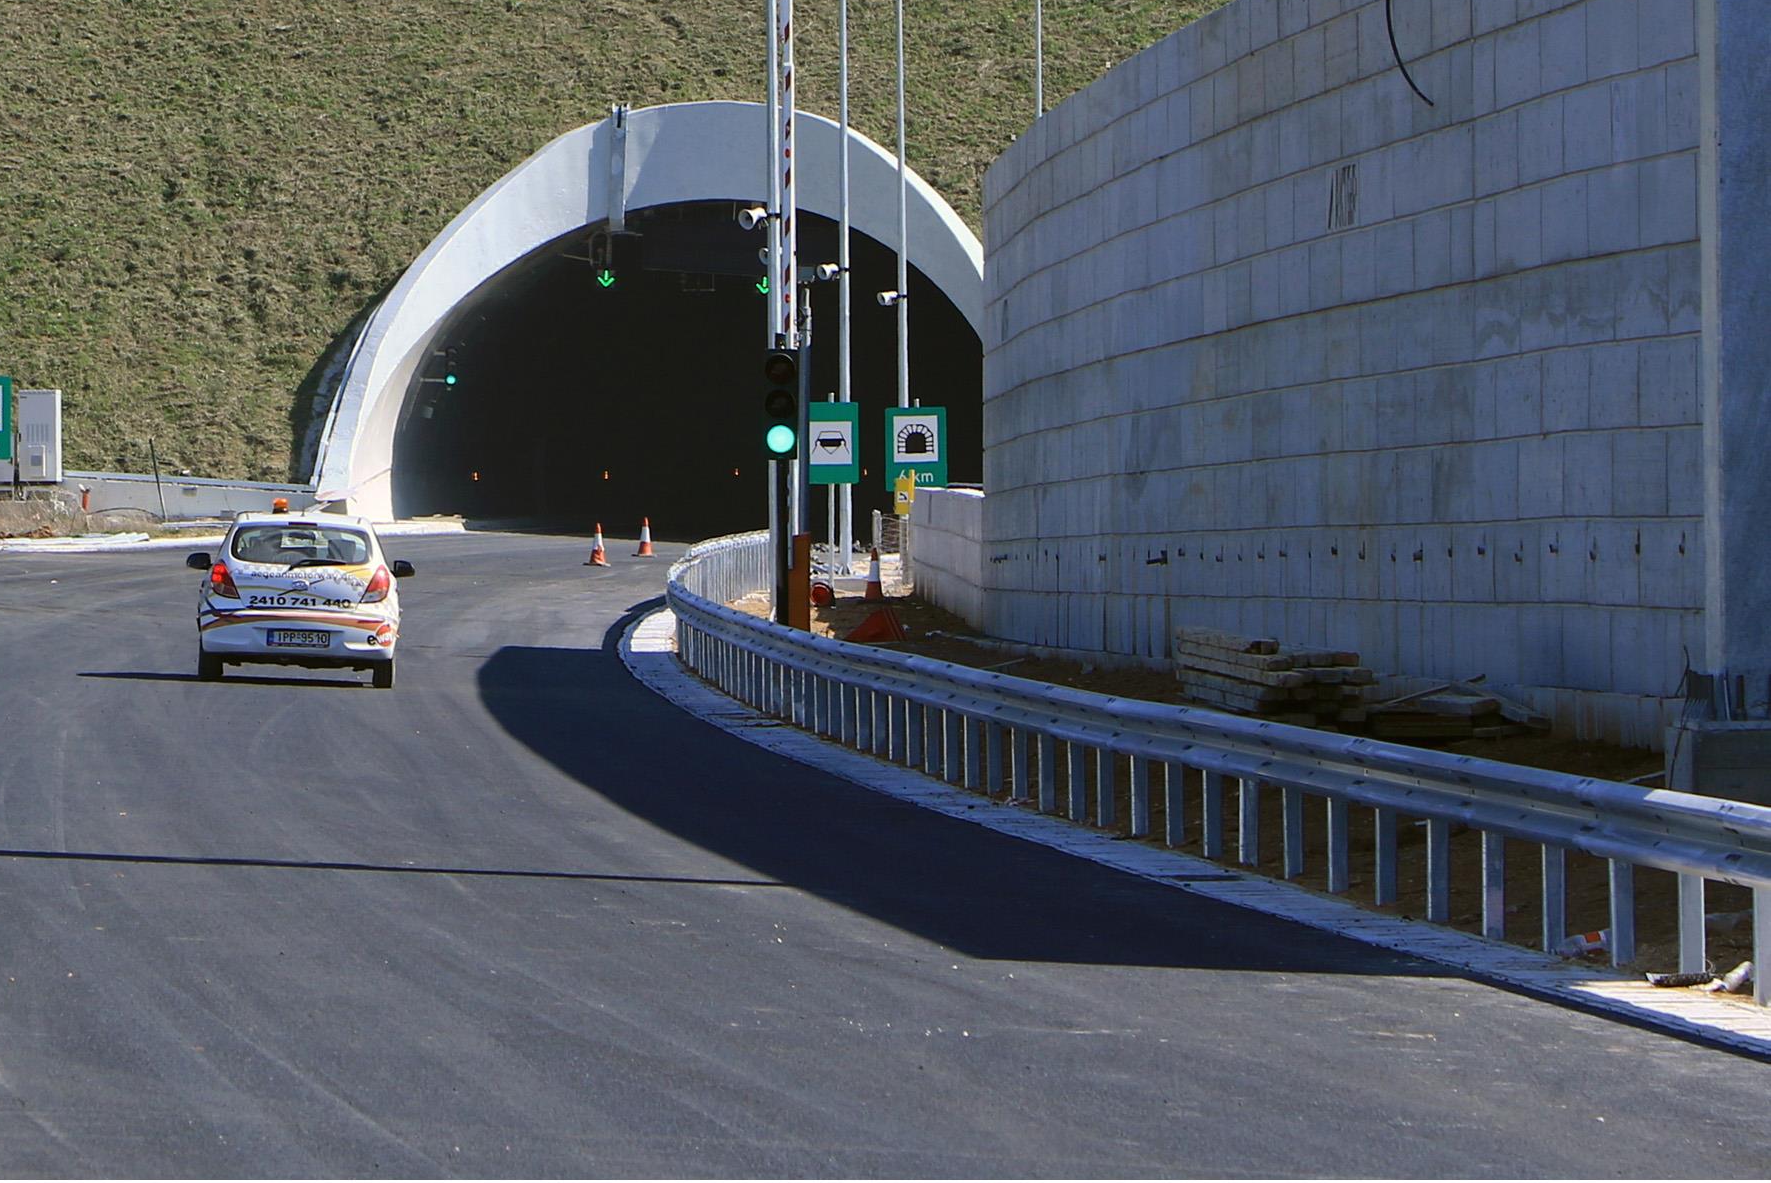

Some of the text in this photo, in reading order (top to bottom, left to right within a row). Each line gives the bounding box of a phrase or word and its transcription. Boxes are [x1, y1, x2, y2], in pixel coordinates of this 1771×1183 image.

[249, 595, 352, 609] 2410 741 440
